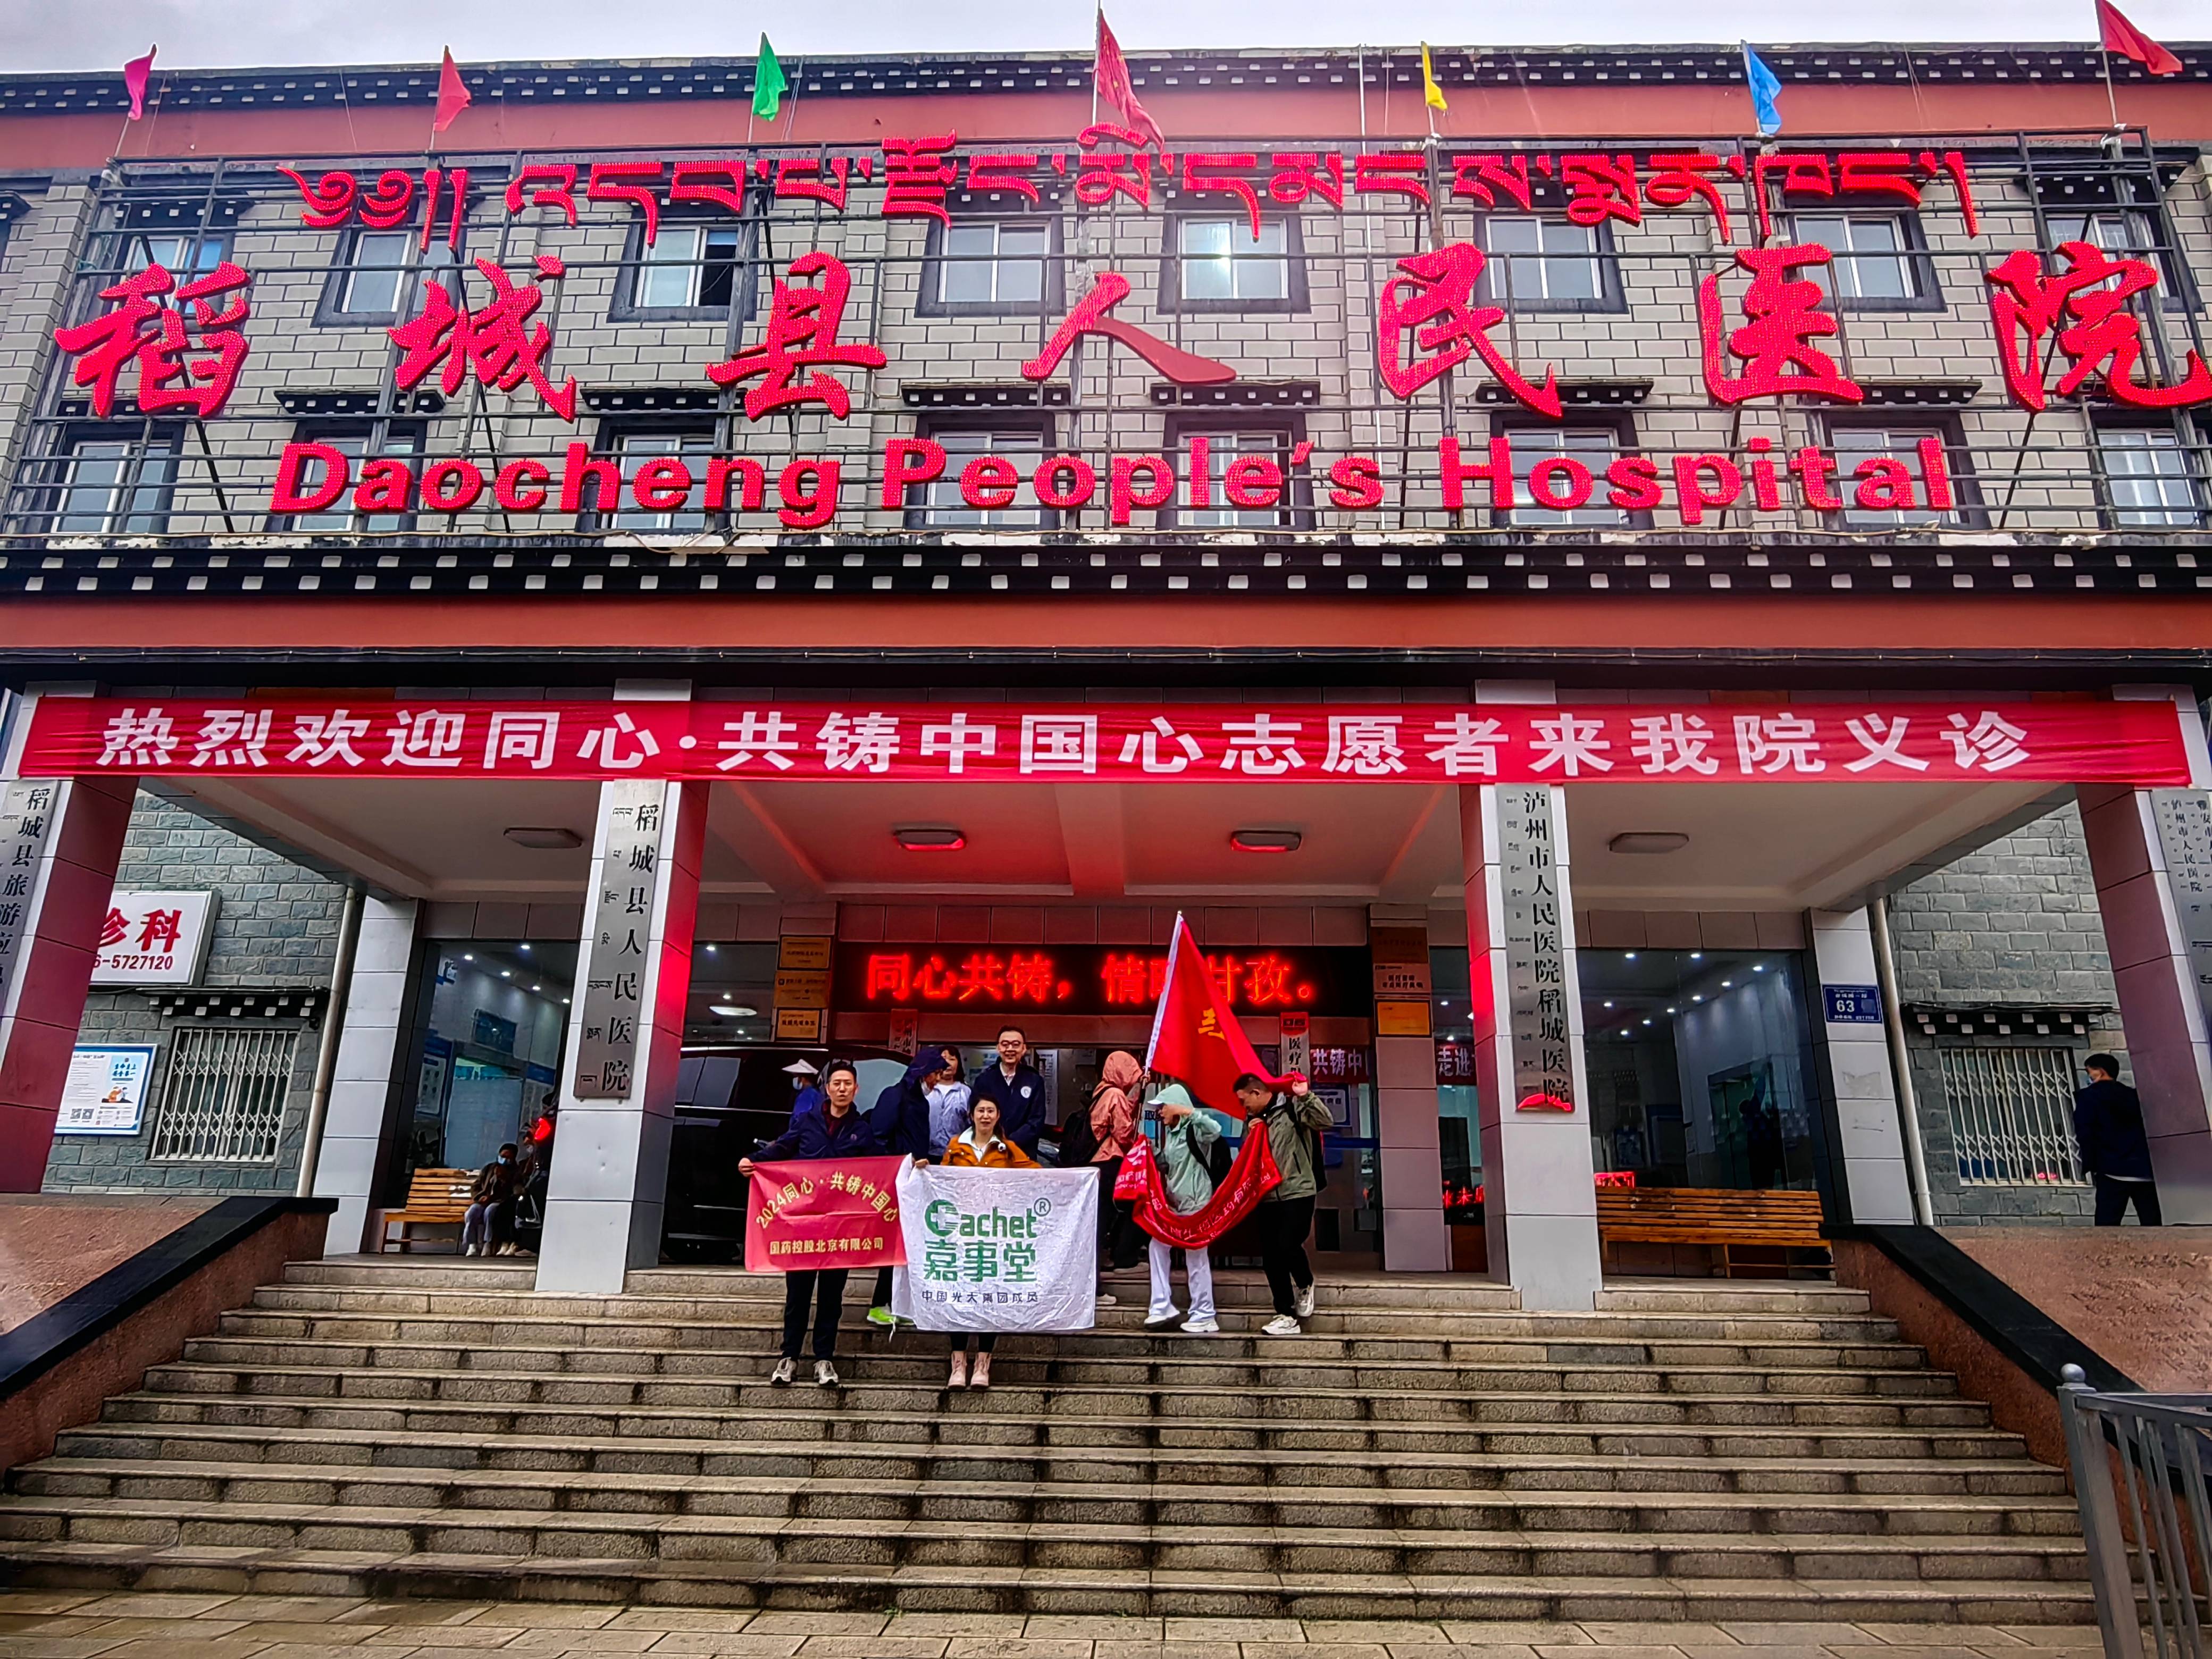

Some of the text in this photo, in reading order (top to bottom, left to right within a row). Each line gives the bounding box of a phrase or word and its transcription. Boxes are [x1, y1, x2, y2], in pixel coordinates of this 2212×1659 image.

[54, 240, 2212, 420] 稻城县人民医院
[269, 439, 842, 531] Daocheng
[1438, 435, 1954, 525] Hospital
[96, 707, 2031, 776] 热烈欢迎同心·共铸中国心志愿者来我院义诊
[601, 804, 660, 1092] 稻城县人民医院
[1522, 790, 1572, 1107] 泸州市人民医院稻城医院
[1836, 1000, 1855, 1013] 63
[769, 1237, 884, 1255] 国药控股北京有限公司
[924, 1239, 1038, 1283] 嘉事堂
[921, 1289, 1038, 1304] 中国光大集团成员
